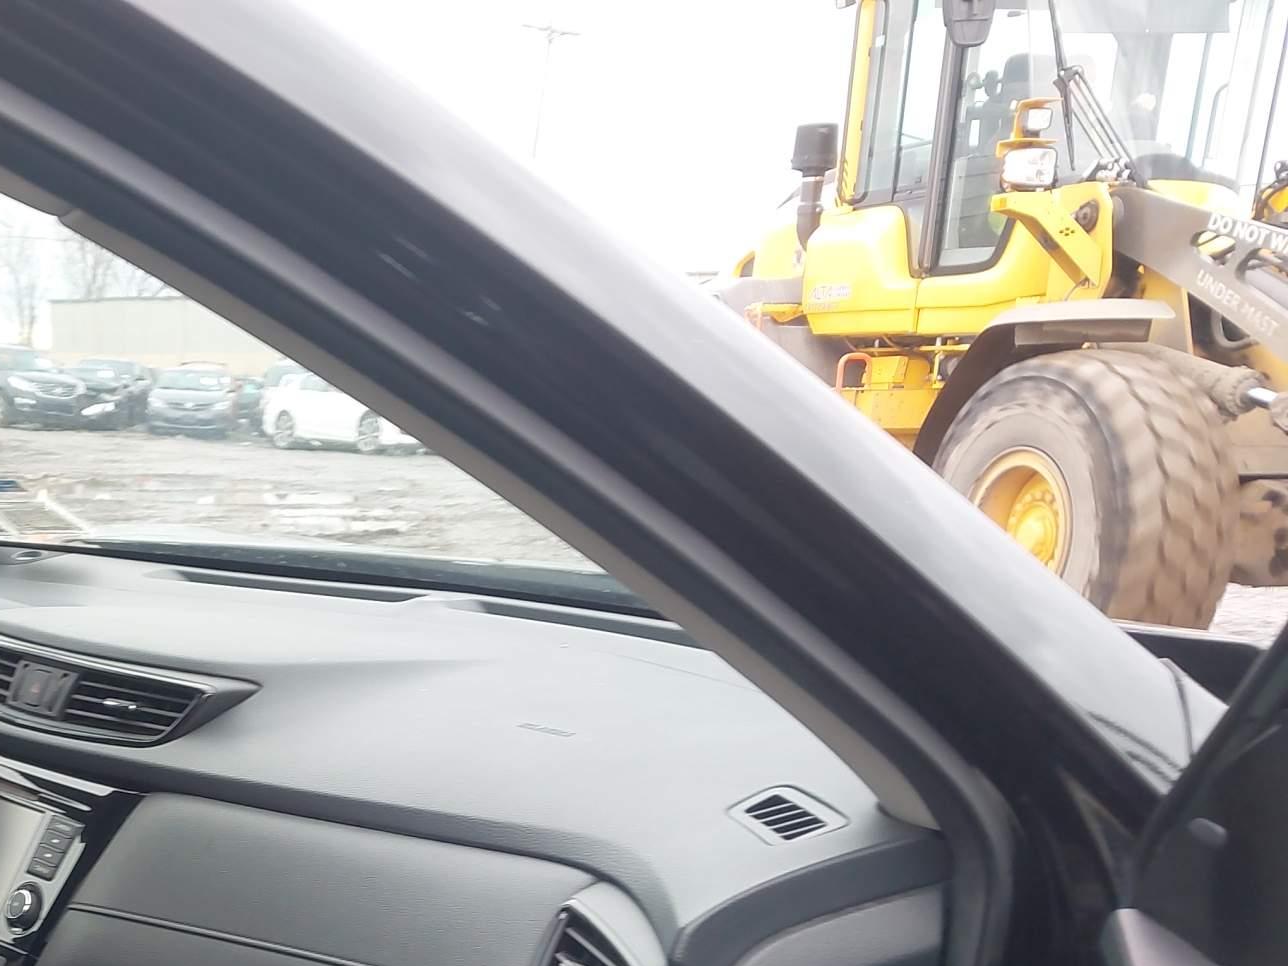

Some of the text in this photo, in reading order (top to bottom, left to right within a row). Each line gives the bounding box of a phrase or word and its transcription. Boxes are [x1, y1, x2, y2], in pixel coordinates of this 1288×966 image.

[1208, 212, 1232, 234] DO
[1233, 220, 1270, 245] NOT
[1197, 270, 1242, 310] UNDER
